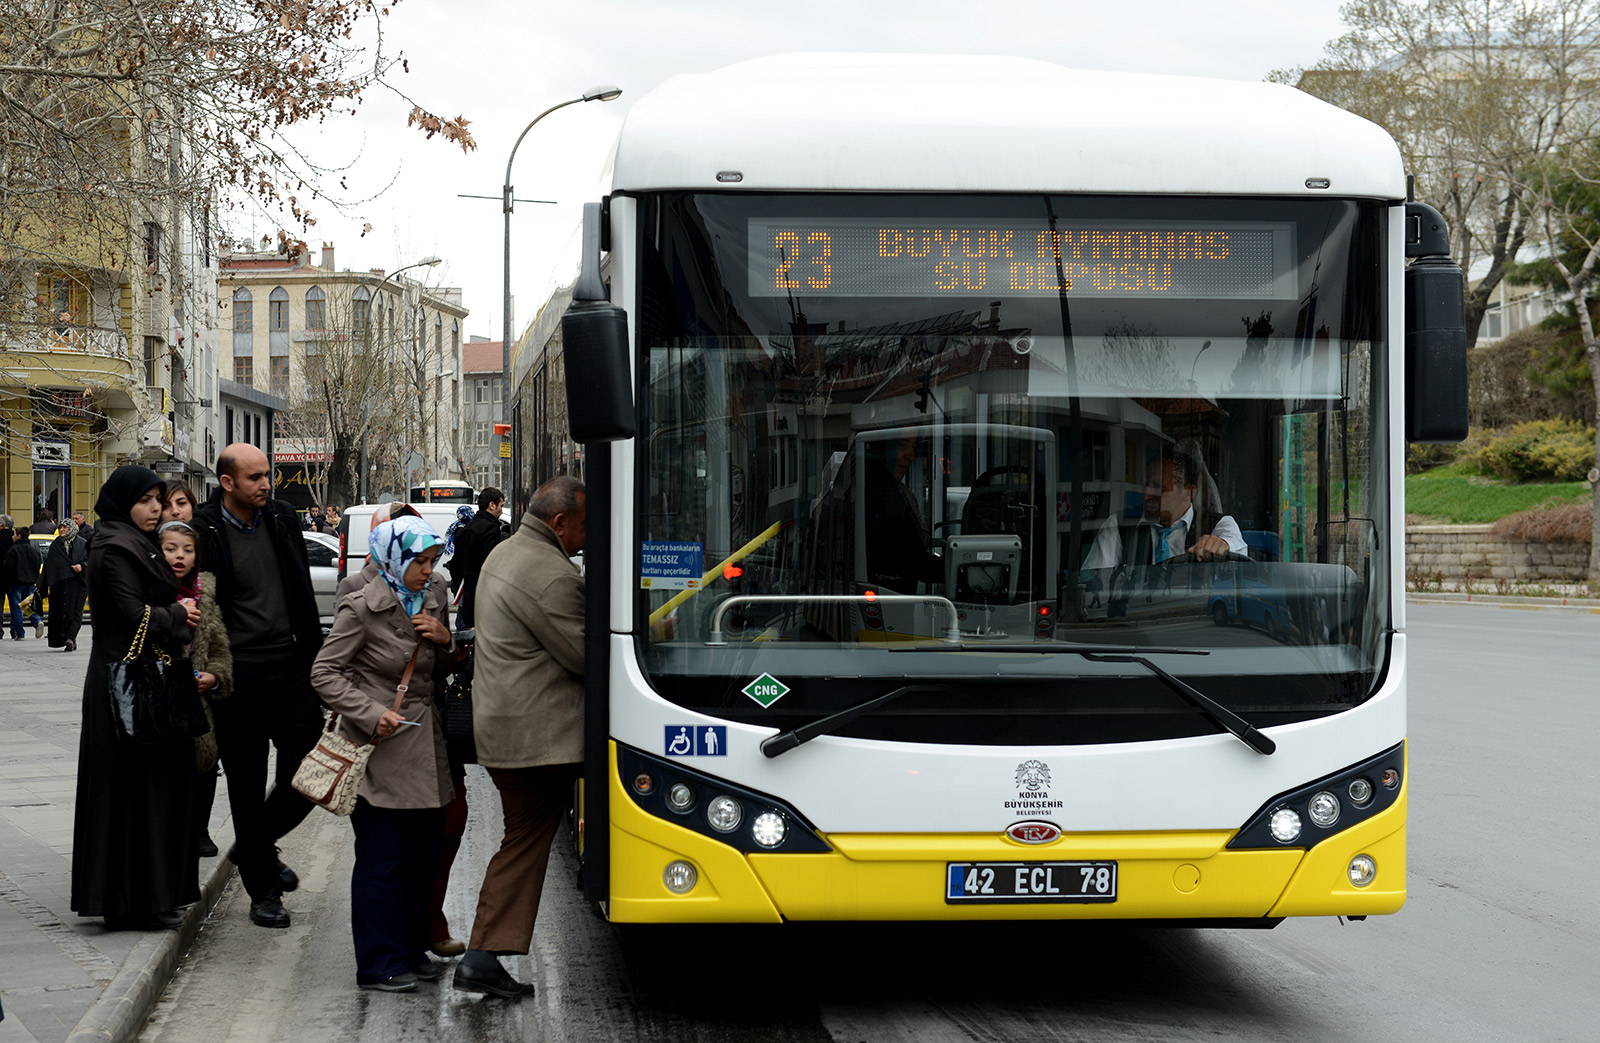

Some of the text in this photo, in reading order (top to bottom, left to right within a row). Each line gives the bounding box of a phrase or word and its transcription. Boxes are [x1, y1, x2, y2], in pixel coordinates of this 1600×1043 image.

[879, 229, 1230, 259] BÜYÜK AYMANAS
[775, 231, 831, 289] 23
[935, 261, 1172, 291] SU DEPOSU
[650, 544, 668, 552] araçta
[643, 555, 679, 564] TEMASSIZ
[754, 684, 778, 696] CNG
[1019, 791, 1048, 799] KONYA
[1004, 799, 1063, 809] BÜYÜKŞEHİR
[964, 867, 995, 894] 42
[1014, 867, 1060, 894] ECL
[1080, 867, 1110, 893] 78
